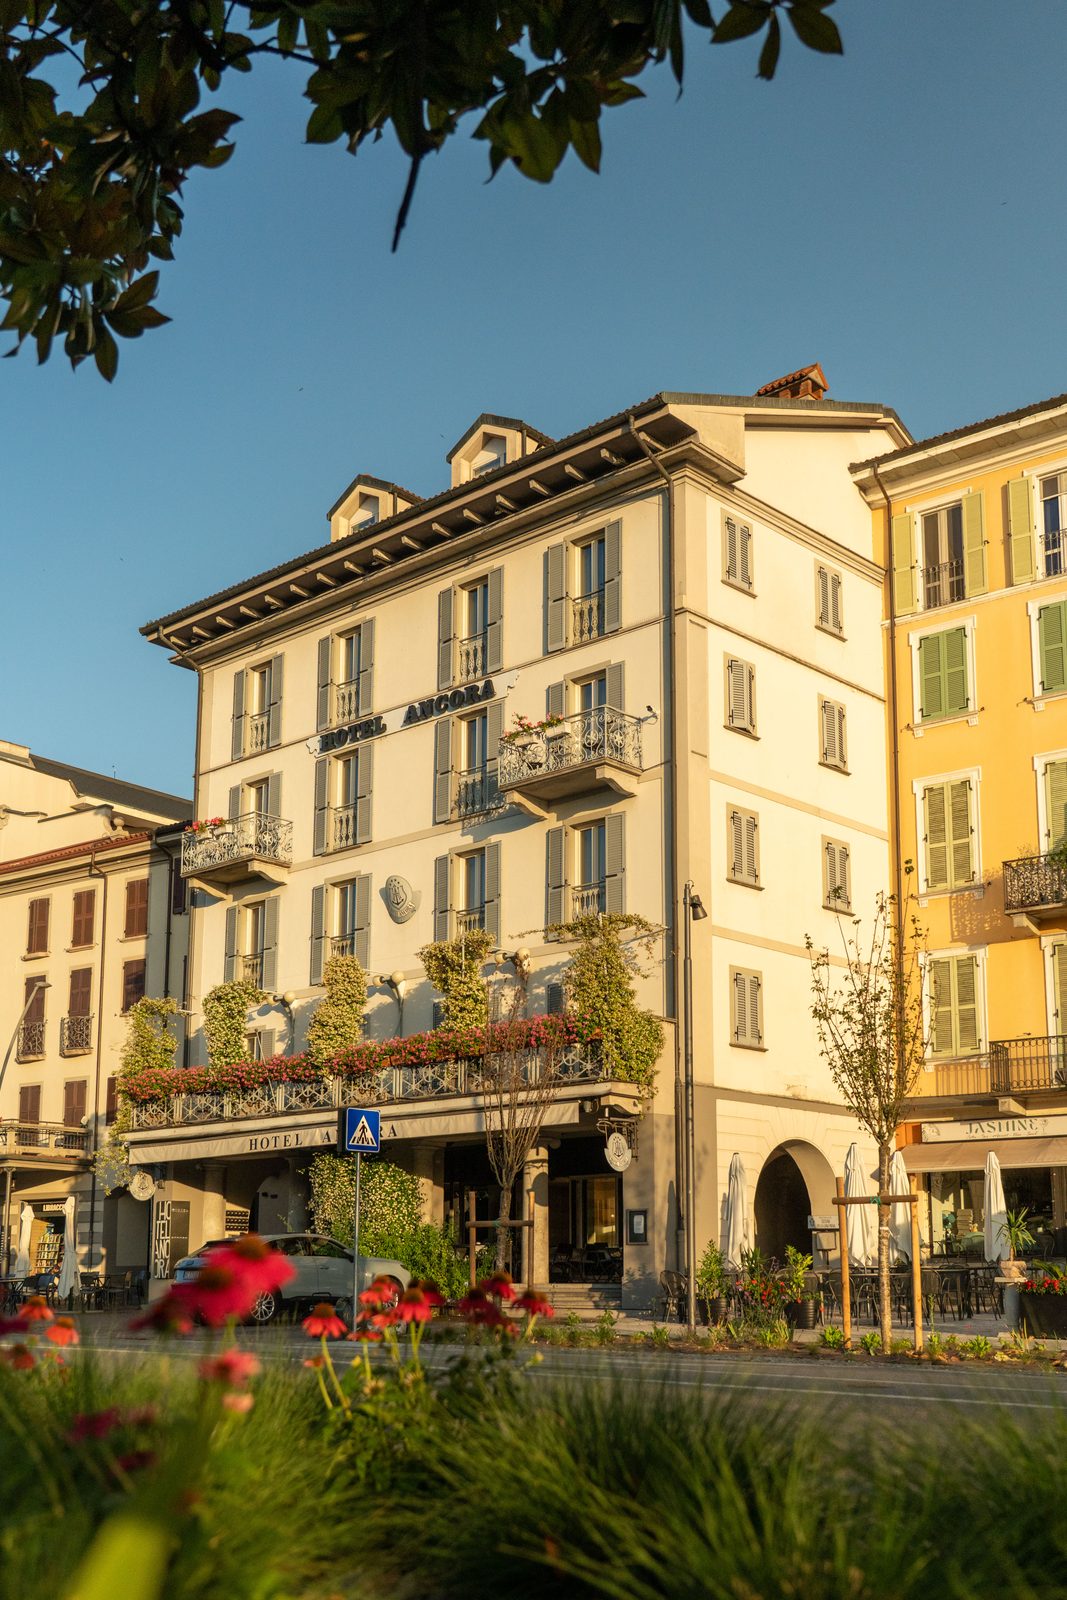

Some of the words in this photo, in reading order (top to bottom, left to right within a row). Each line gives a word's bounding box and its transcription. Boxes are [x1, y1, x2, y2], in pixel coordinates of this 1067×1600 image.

[319, 716, 387, 751] HOTEL
[403, 679, 496, 725] ANCORA
[250, 1133, 304, 1150] HOTEL
[322, 1124, 398, 1143] ARA
[966, 1119, 1038, 1135] JASMINE
